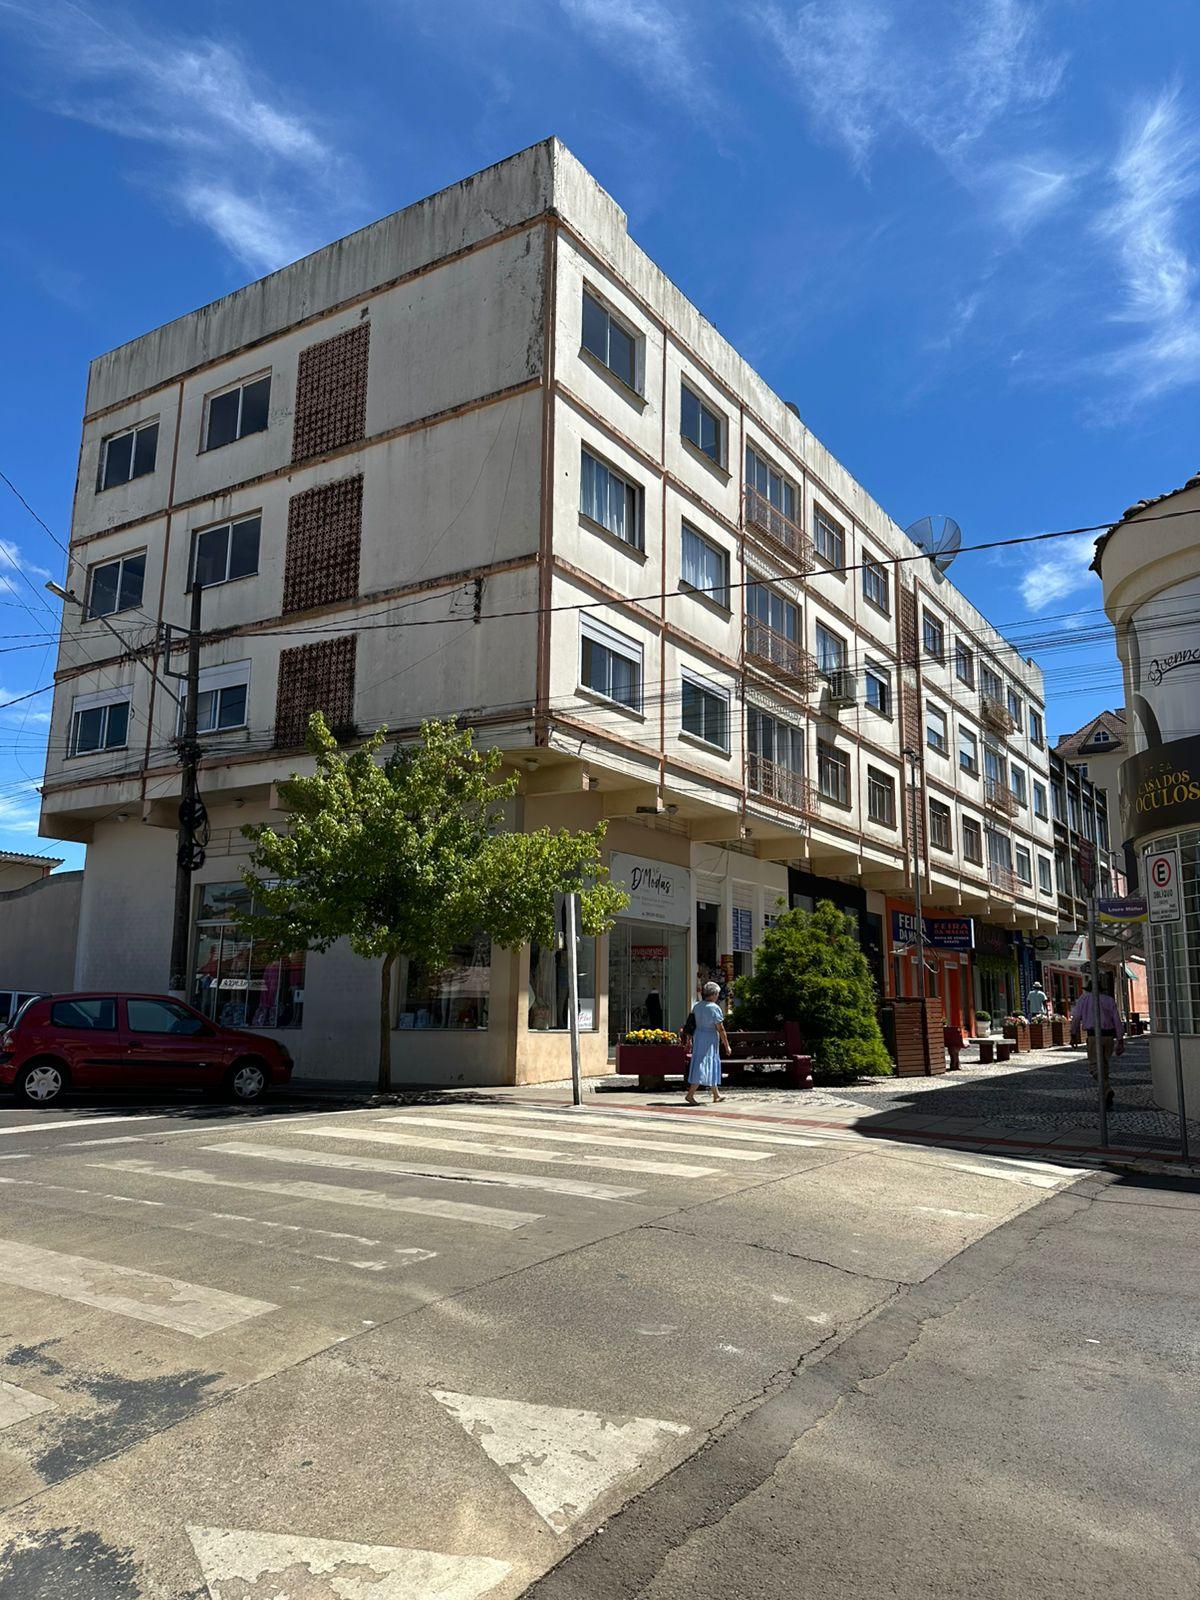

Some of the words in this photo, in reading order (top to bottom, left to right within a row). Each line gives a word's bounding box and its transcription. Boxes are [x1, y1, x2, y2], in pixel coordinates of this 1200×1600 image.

[1138, 777, 1161, 795] CASA
[1163, 770, 1190, 787] DOS
[1157, 863, 1165, 882] E
